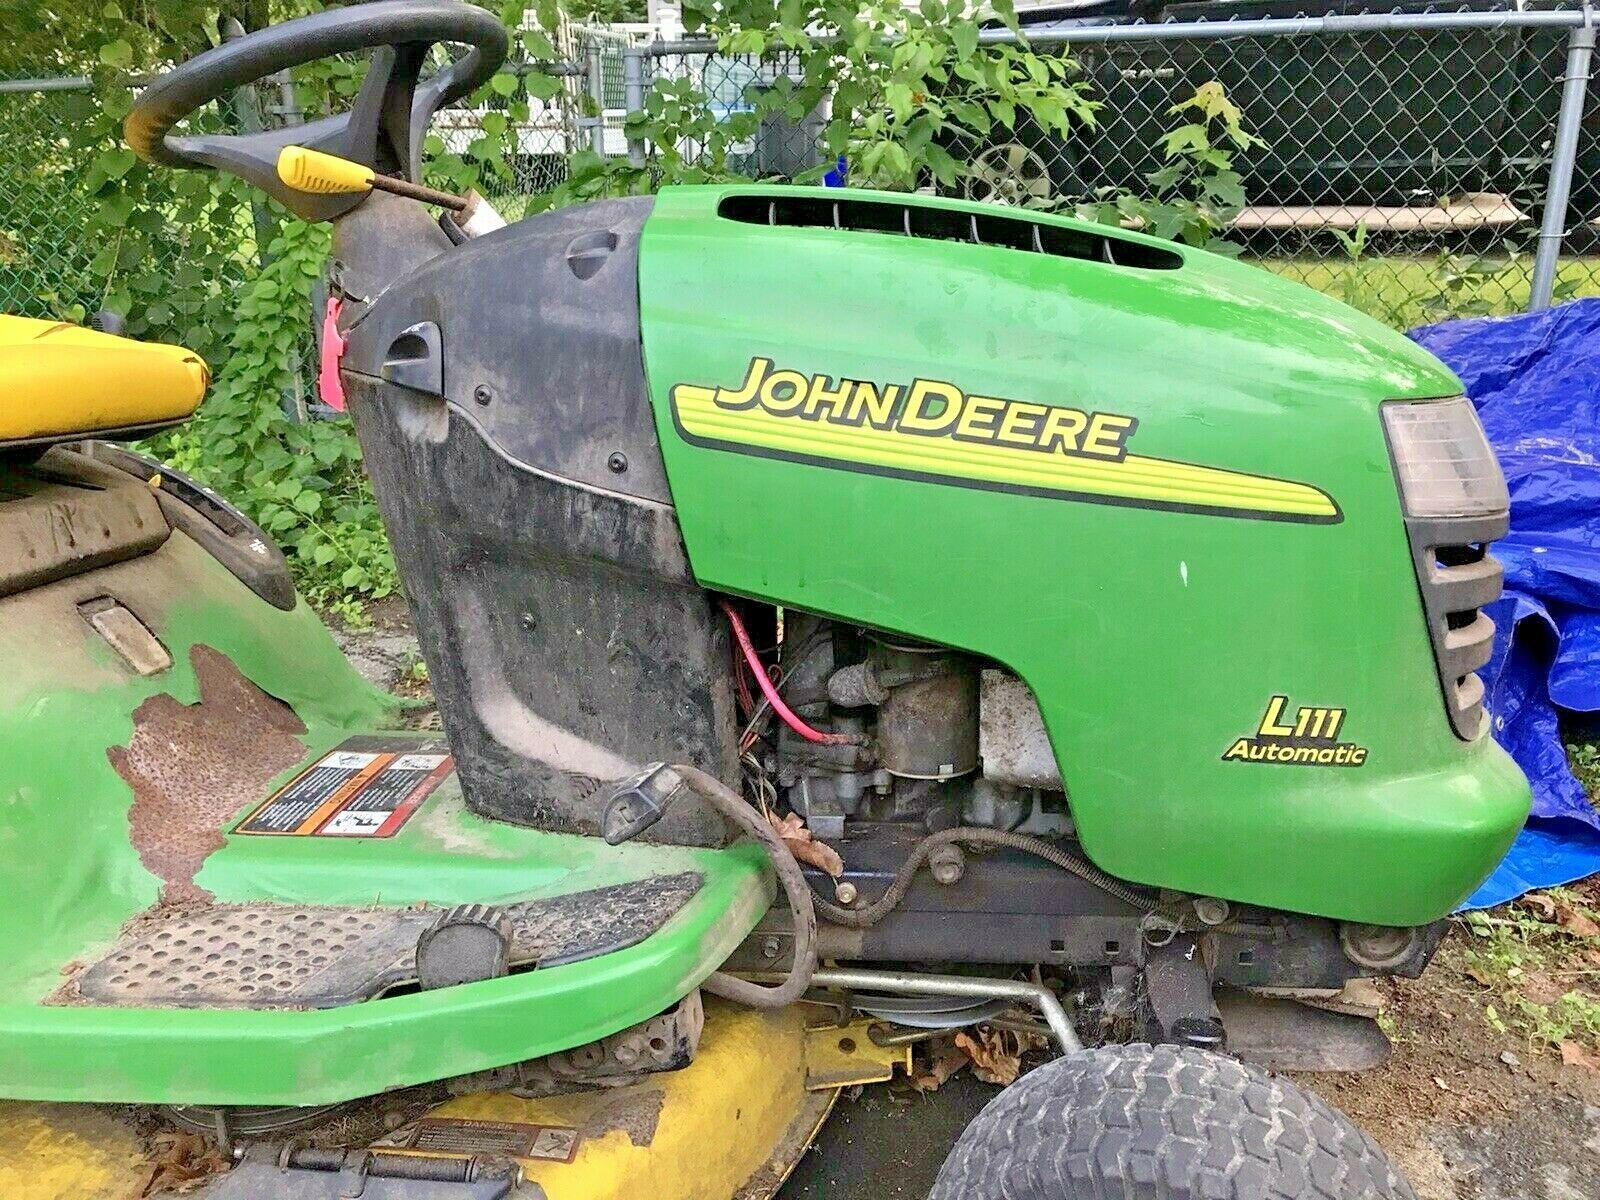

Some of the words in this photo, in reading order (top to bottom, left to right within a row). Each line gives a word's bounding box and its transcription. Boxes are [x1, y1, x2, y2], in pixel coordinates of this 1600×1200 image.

[715, 357, 904, 430] JOHN
[899, 378, 1136, 461] DEERE
[1258, 696, 1346, 739] L111
[1223, 739, 1367, 765] Automatic
